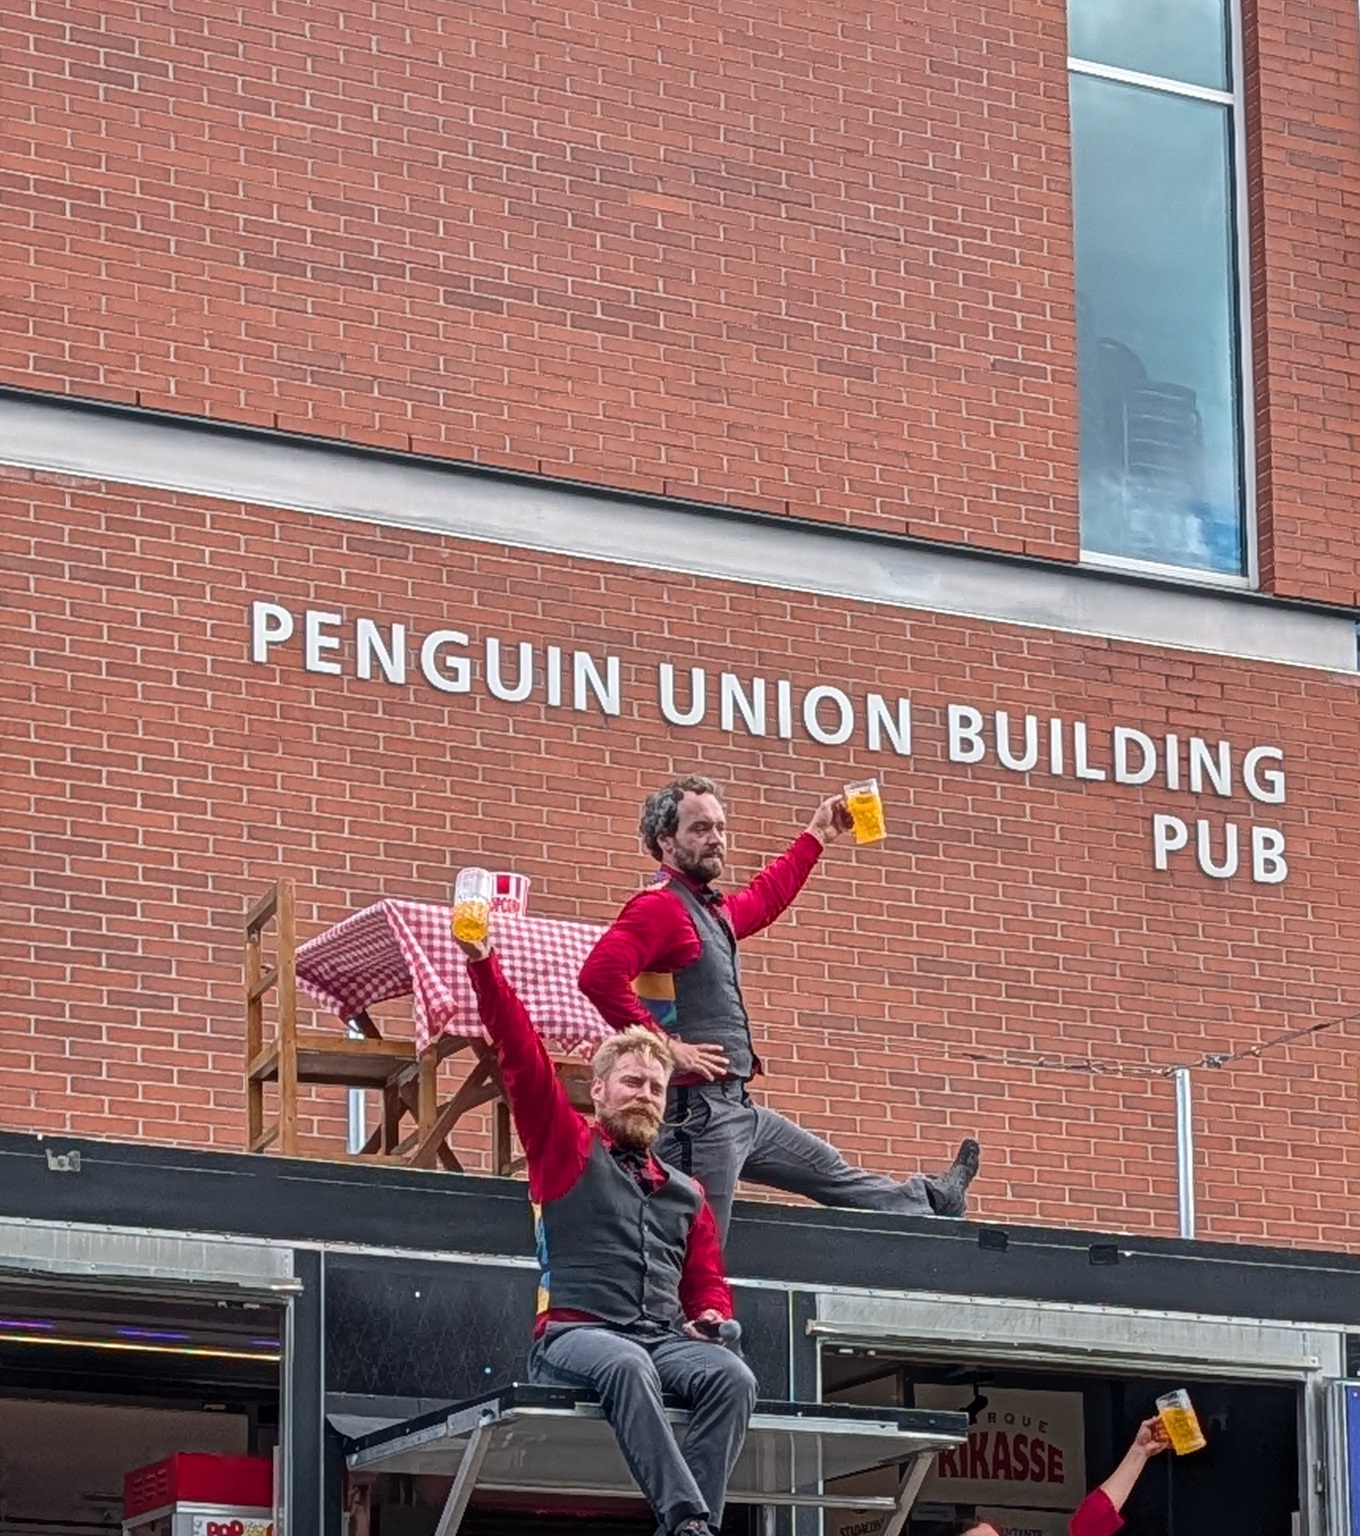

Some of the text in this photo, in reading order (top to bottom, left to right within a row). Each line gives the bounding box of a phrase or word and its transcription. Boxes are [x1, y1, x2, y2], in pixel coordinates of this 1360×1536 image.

[252, 600, 1287, 804] PENGUIN UNION BUILDING
[1152, 813, 1288, 884] PUB
[987, 1411, 1050, 1435] RQUE
[938, 1431, 1065, 1484] KIKASSE
